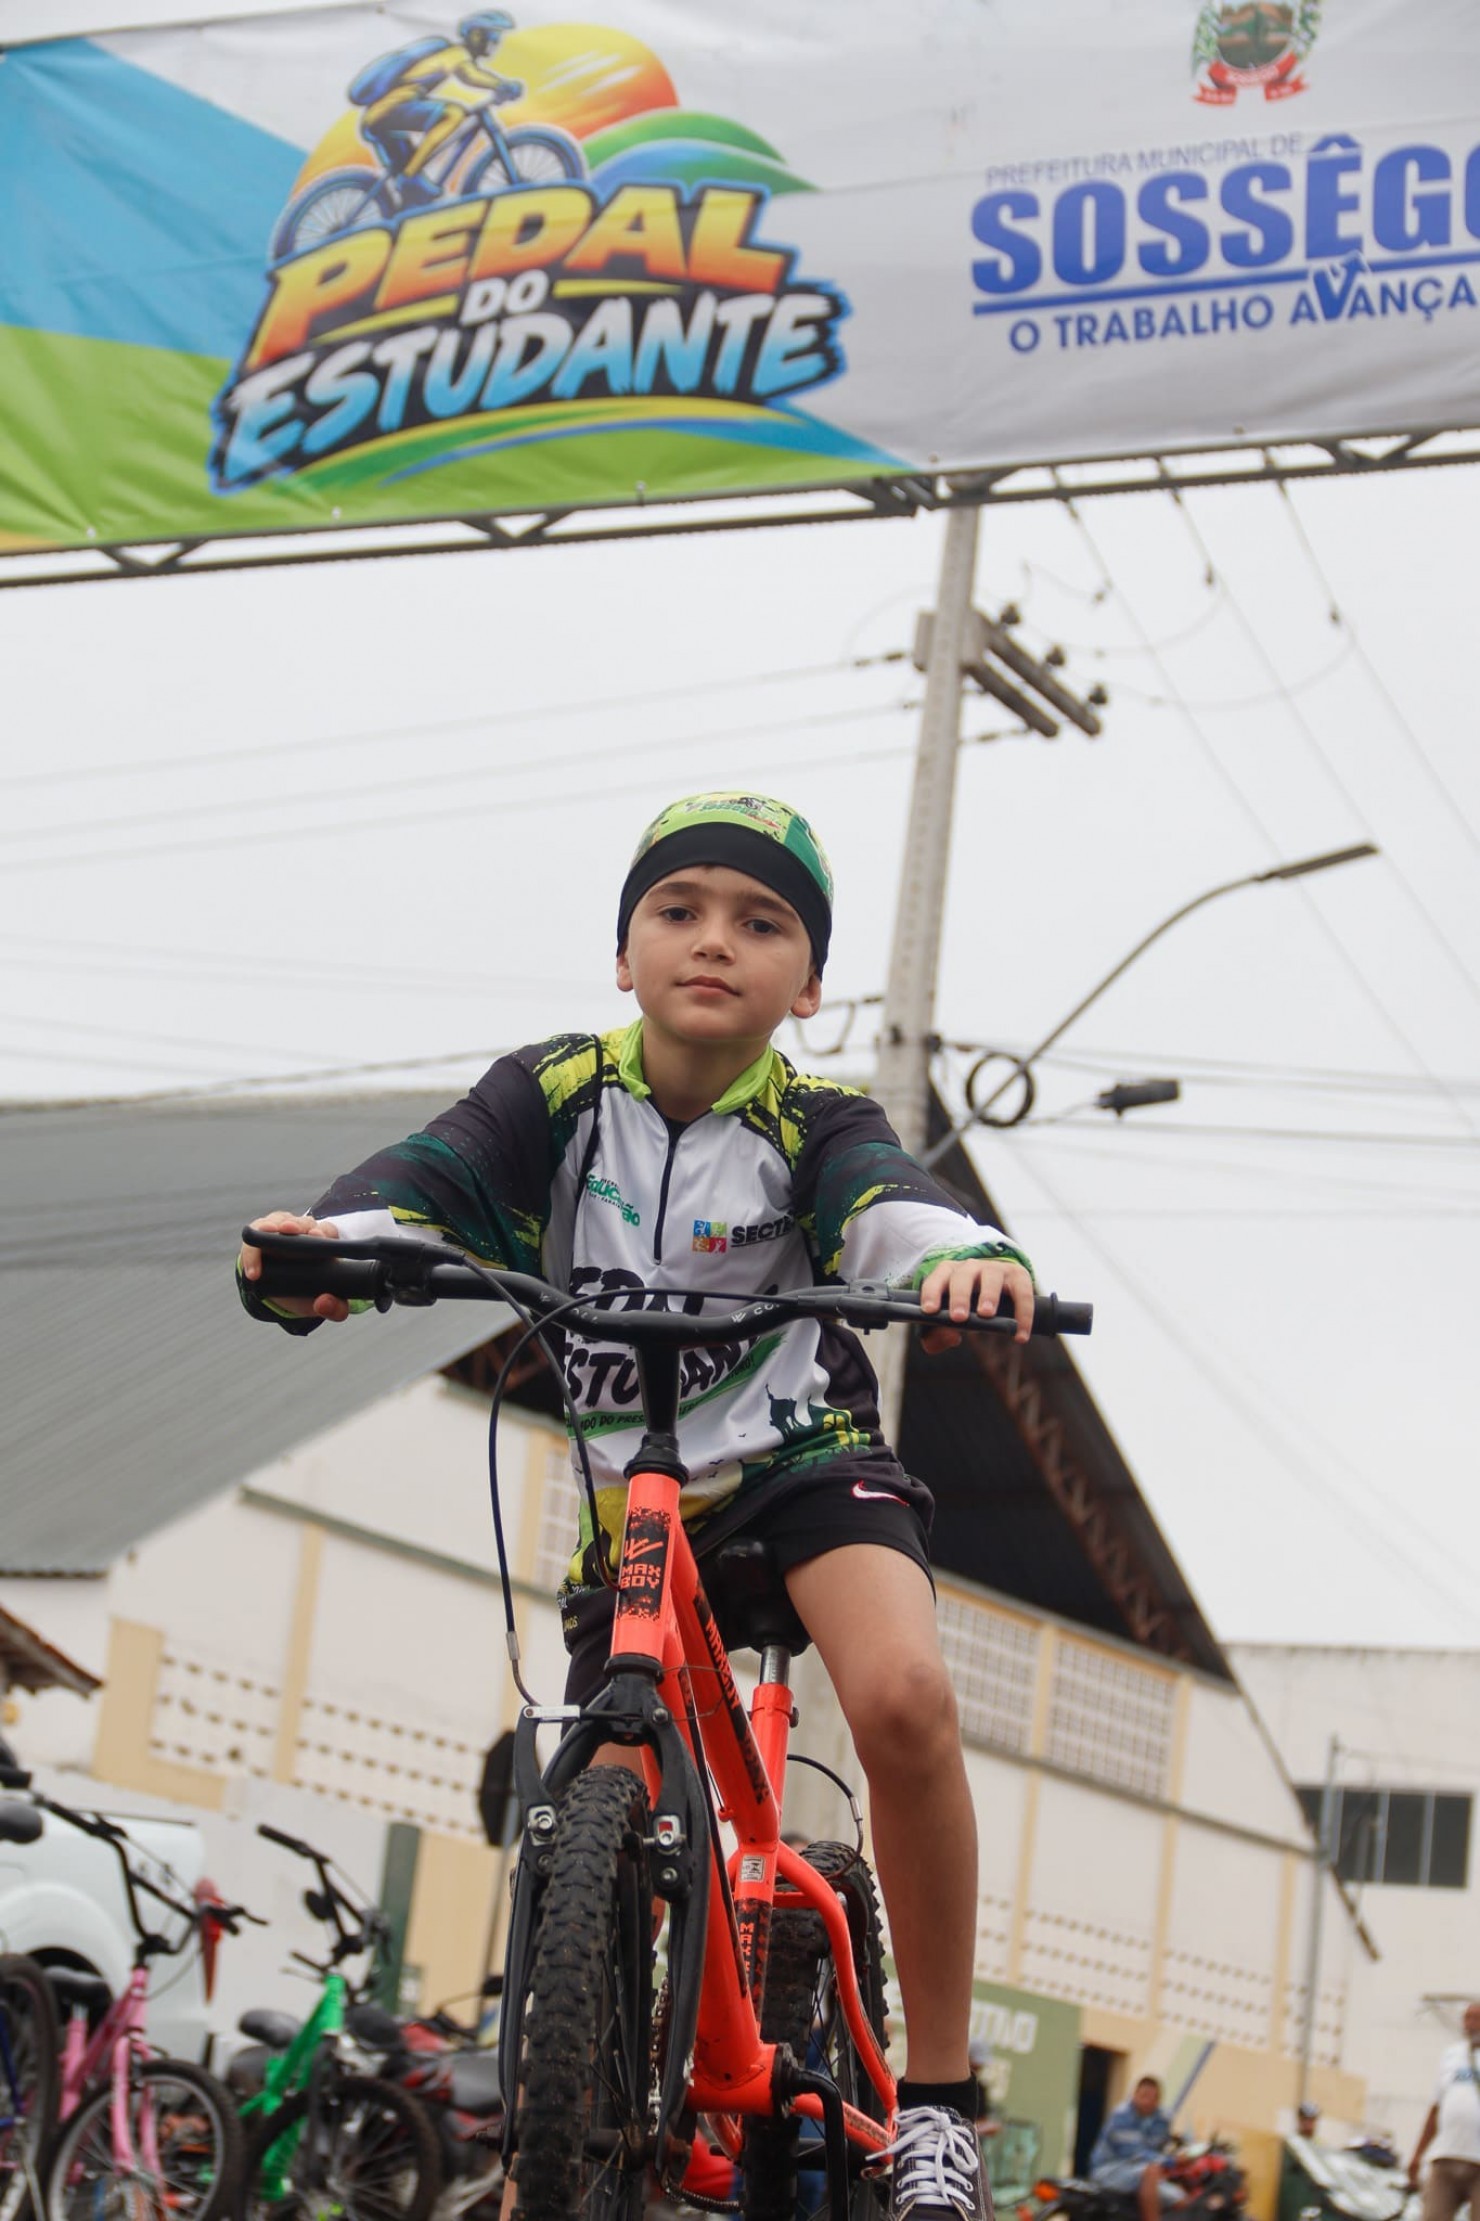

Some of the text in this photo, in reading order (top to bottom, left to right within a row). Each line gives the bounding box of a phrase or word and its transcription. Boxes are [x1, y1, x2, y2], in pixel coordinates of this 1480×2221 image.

[985, 132, 1303, 187] PREFEITURA MUNICIPAL DE
[971, 134, 1480, 294] SOSSÊG
[244, 184, 790, 370] PEDAL
[458, 269, 550, 327] DO
[1009, 252, 1478, 354] O TRABALHO AVANÇA
[221, 290, 840, 484] ESTUDANTE
[620, 1576, 660, 1590] BOY
[621, 1563, 661, 1577] MAX
